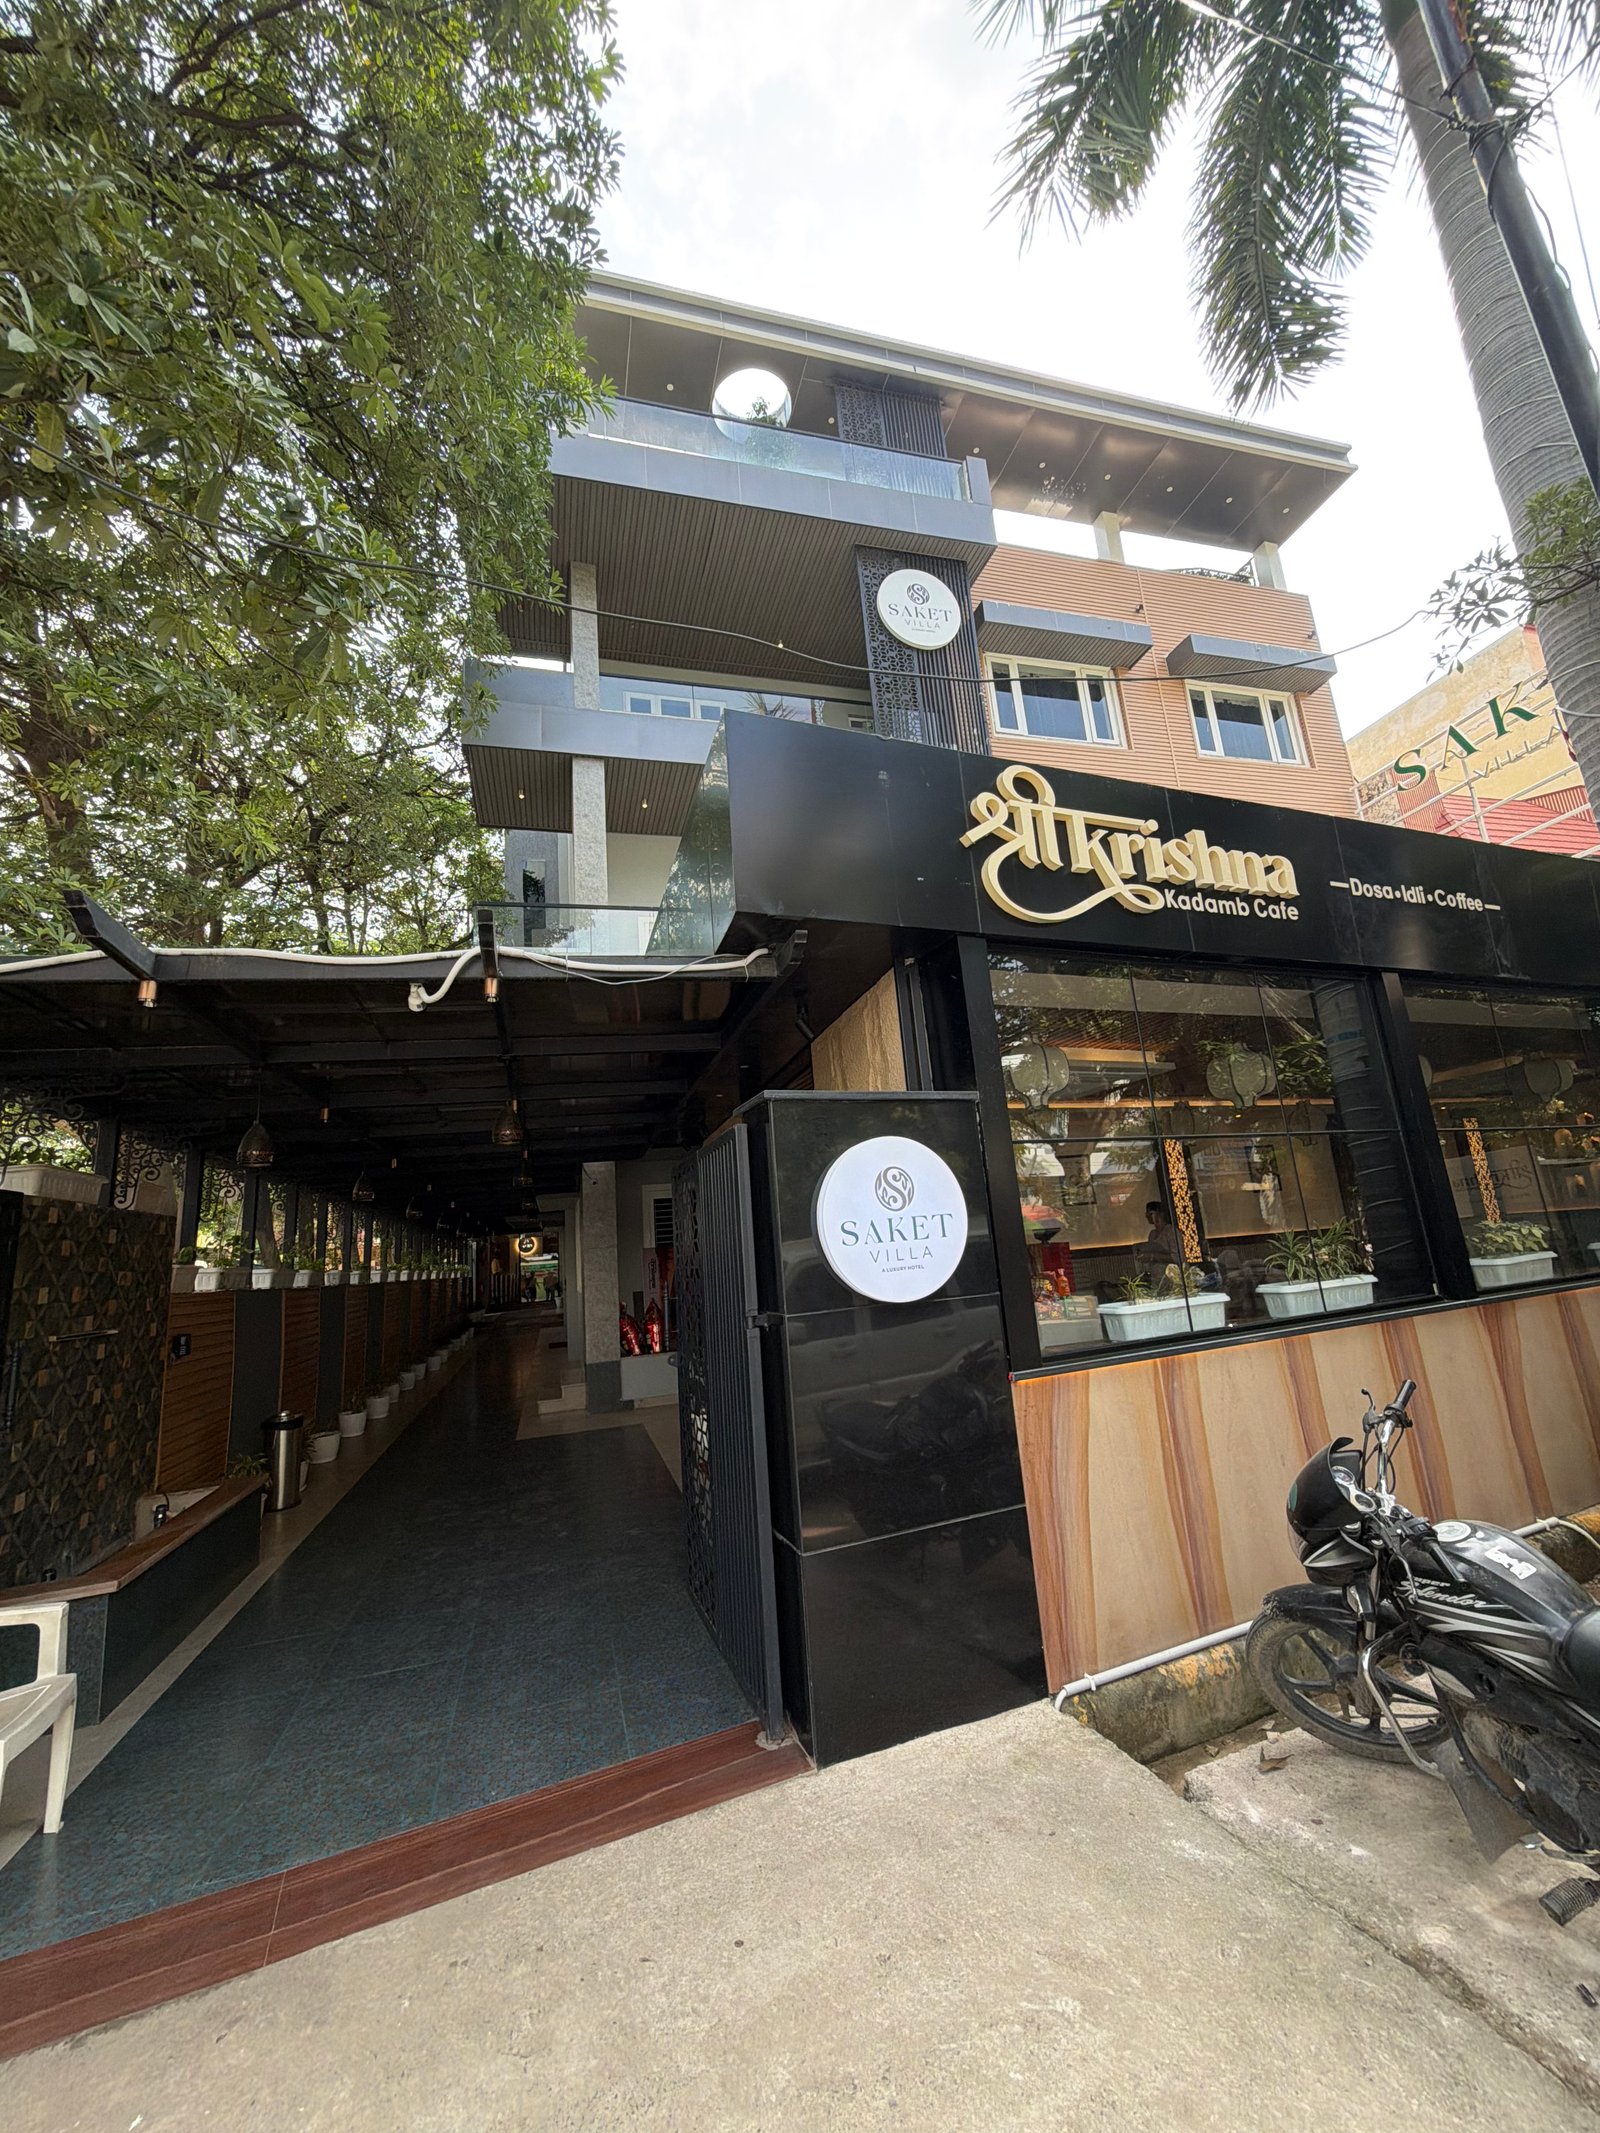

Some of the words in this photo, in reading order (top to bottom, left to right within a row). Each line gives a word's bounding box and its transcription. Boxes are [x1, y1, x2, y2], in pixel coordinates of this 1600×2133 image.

[888, 603, 952, 622] SAKET
[904, 618, 941, 629] VILLA
[1164, 888, 1250, 917] Kadamb
[1254, 898, 1300, 921] Cafe
[840, 1213, 953, 1247] SAKET
[869, 1245, 933, 1264] VILLA
